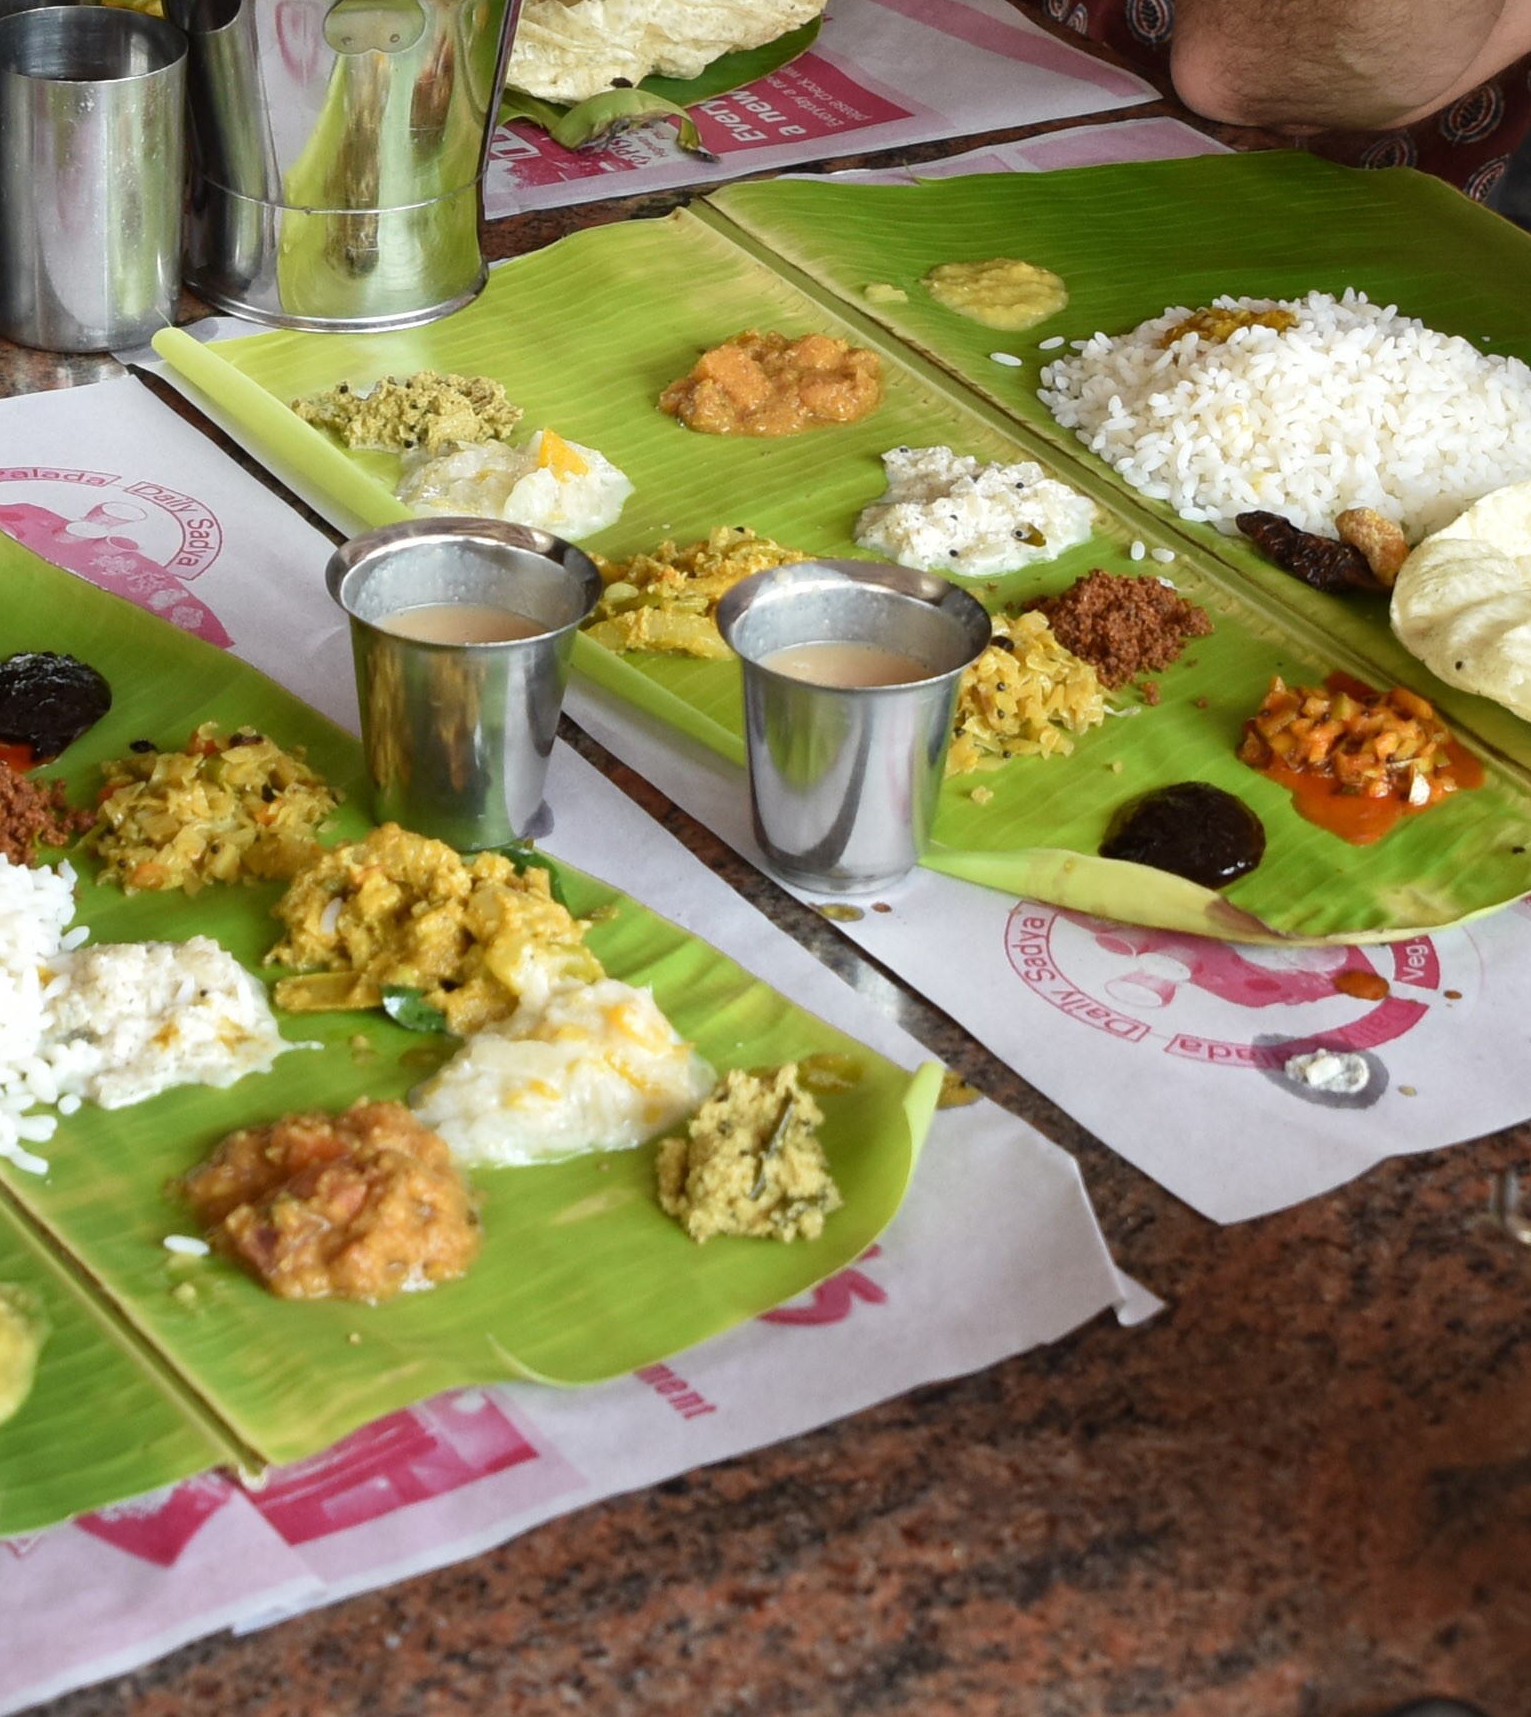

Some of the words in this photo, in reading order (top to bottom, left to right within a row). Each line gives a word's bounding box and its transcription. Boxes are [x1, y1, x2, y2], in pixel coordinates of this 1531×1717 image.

[698, 99, 768, 142] Every
[778, 124, 807, 136] a
[791, 95, 845, 128] Everyday
[133, 485, 198, 514] Daily
[177, 518, 214, 568] Sadya
[1011, 915, 1057, 982] Sadya
[1050, 989, 1140, 1036] Daily
